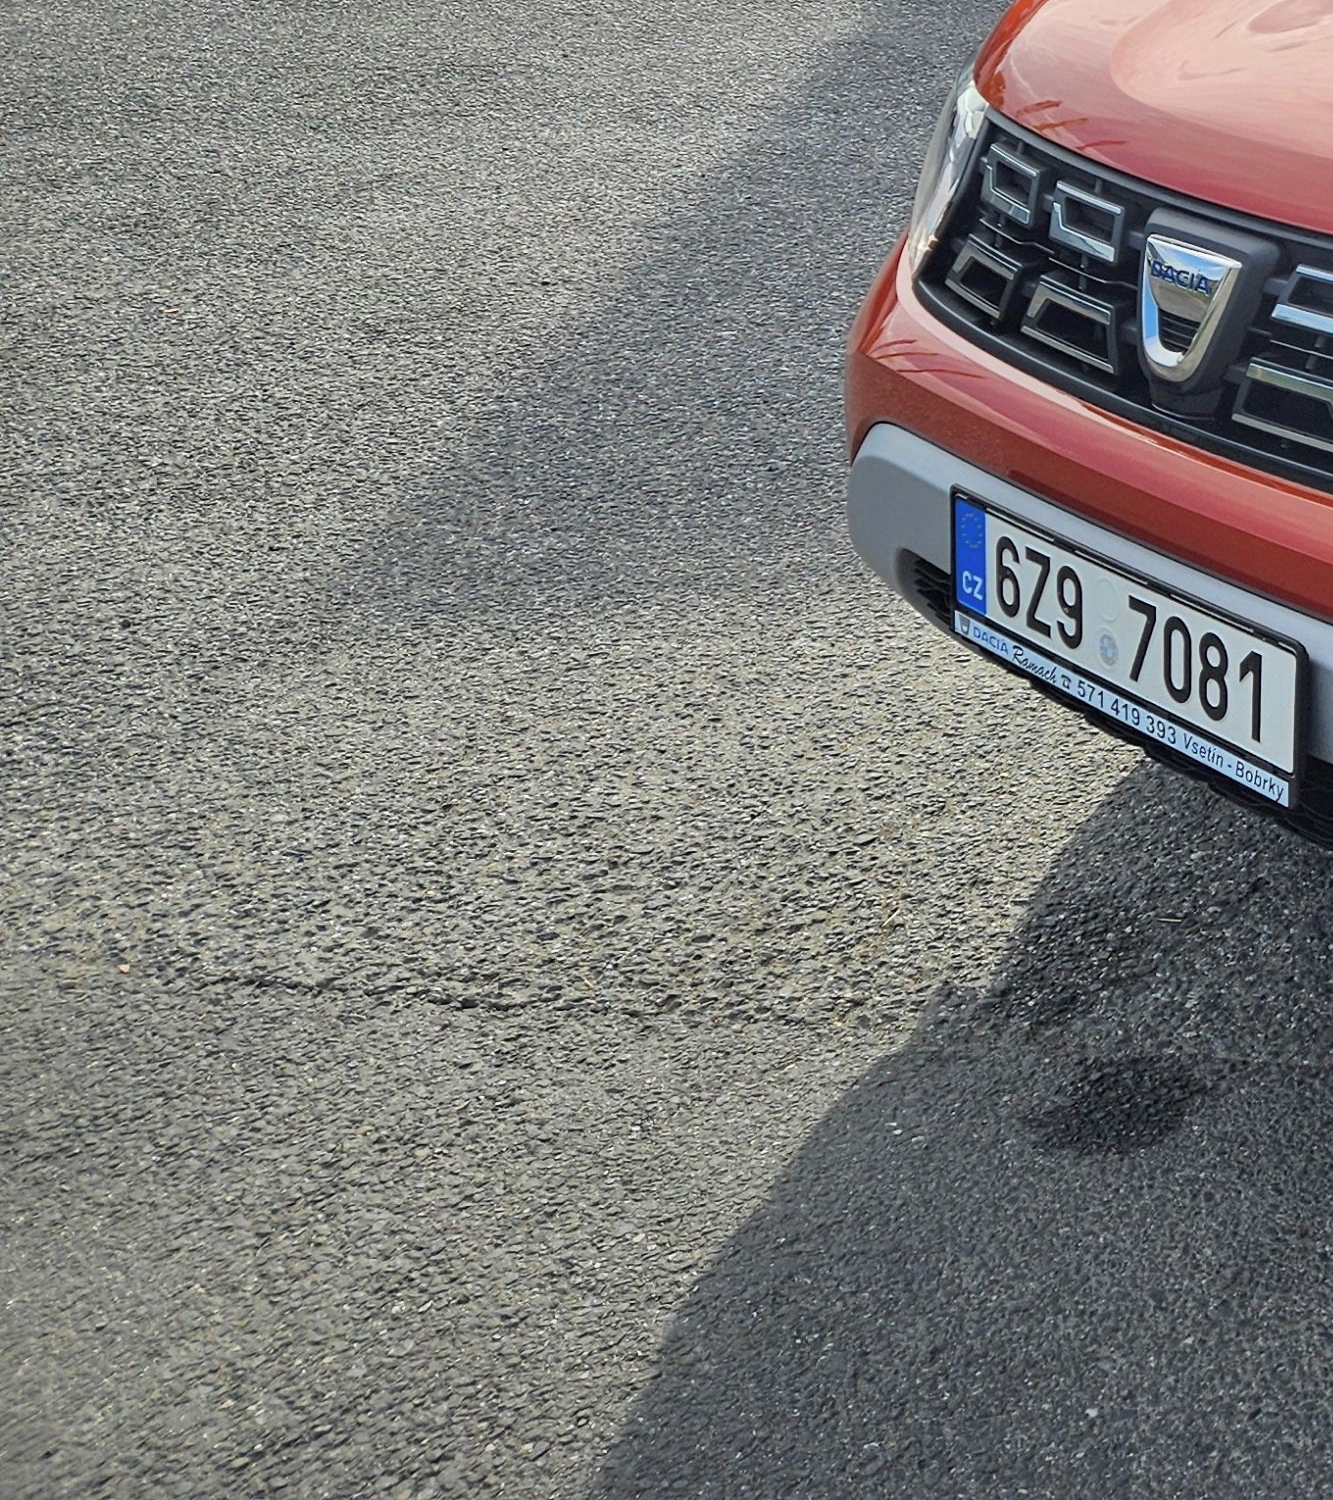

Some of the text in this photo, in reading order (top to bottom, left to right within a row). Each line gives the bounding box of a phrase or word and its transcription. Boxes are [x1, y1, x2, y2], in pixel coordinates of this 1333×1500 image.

[1151, 260, 1209, 295] DACIA
[962, 570, 984, 601] CZ
[996, 536, 1263, 744] 6Z9 7081
[973, 626, 1009, 656] DACIA
[1077, 679, 1105, 709] 571
[1110, 697, 1140, 727] 419
[1146, 715, 1177, 746] 393
[1183, 732, 1224, 769] Vsetín
[1235, 761, 1285, 804] Bobrky
